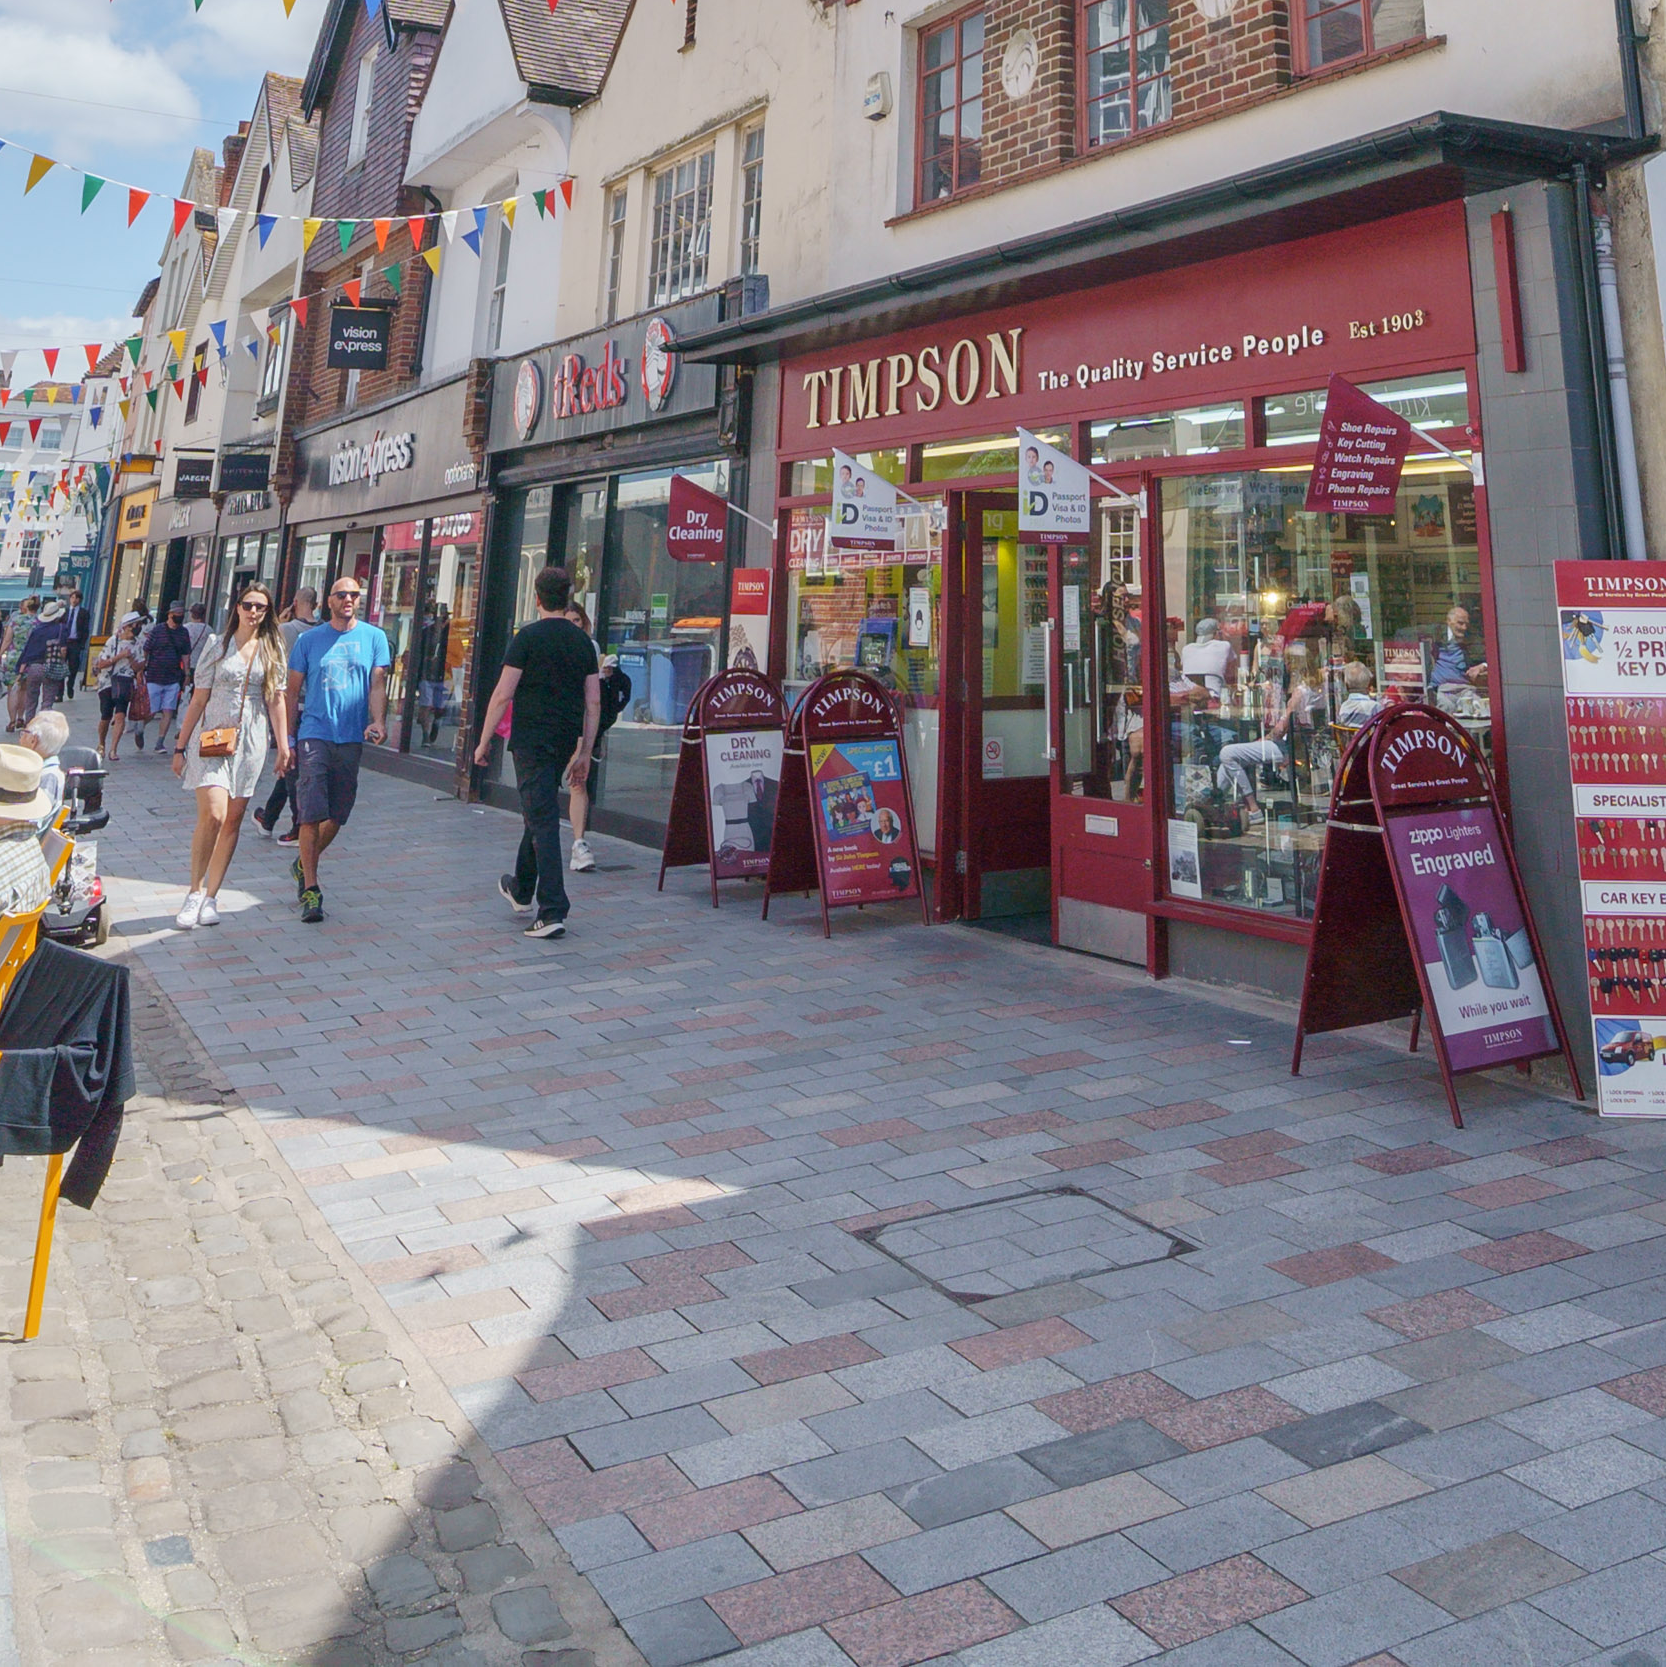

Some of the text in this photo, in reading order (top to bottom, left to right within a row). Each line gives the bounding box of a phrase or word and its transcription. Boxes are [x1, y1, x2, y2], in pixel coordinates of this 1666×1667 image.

[1349, 310, 1424, 339] Est 1903
[343, 326, 377, 340] vision
[334, 340, 382, 353] express
[1038, 326, 1324, 390] The Quality Service People
[803, 328, 1023, 428] TIMPSON
[1341, 423, 1397, 436] Shoe Repairs
[1337, 438, 1386, 451] Key Cutting
[329, 430, 412, 487] vision express
[1334, 454, 1396, 466] Watch Repairs
[179, 474, 211, 483] JAEGER
[445, 461, 475, 491] opticians
[1331, 468, 1374, 481] Engraving
[1264, 484, 1306, 497] Engrav
[1328, 484, 1390, 496] Phone Repairs
[1052, 492, 1086, 503] Passport
[1333, 500, 1369, 508] TIMPSON
[863, 504, 893, 515] Passport
[1052, 504, 1086, 513] Visa & ID
[686, 510, 708, 526] Dry
[1055, 515, 1082, 524] Photos
[669, 526, 723, 542] Cleaning
[865, 524, 888, 532] Photos
[790, 528, 823, 553] DRY
[738, 582, 764, 591] TIMPSON
[1613, 626, 1633, 635] ASK
[1384, 649, 1420, 657] TIMPSON
[1617, 662, 1649, 677] KEY
[710, 683, 775, 710] TIMPSON
[813, 687, 884, 717] TIMPSON
[731, 737, 756, 749] DRY
[720, 750, 771, 762] CLEANING
[1381, 729, 1467, 774] TIMPSON
[874, 755, 898, 777] £1
[1391, 782, 1406, 790] Great
[1593, 795, 1666, 807] SPECIALIST
[1409, 824, 1481, 846] zippo Lighters
[1410, 843, 1495, 877] Engraved
[832, 888, 861, 897] TIMPSON
[1600, 892, 1627, 904] CAR
[1632, 893, 1656, 905] KEY
[1459, 994, 1531, 1019] While you wait
[1483, 1028, 1523, 1045] TIMPSON
